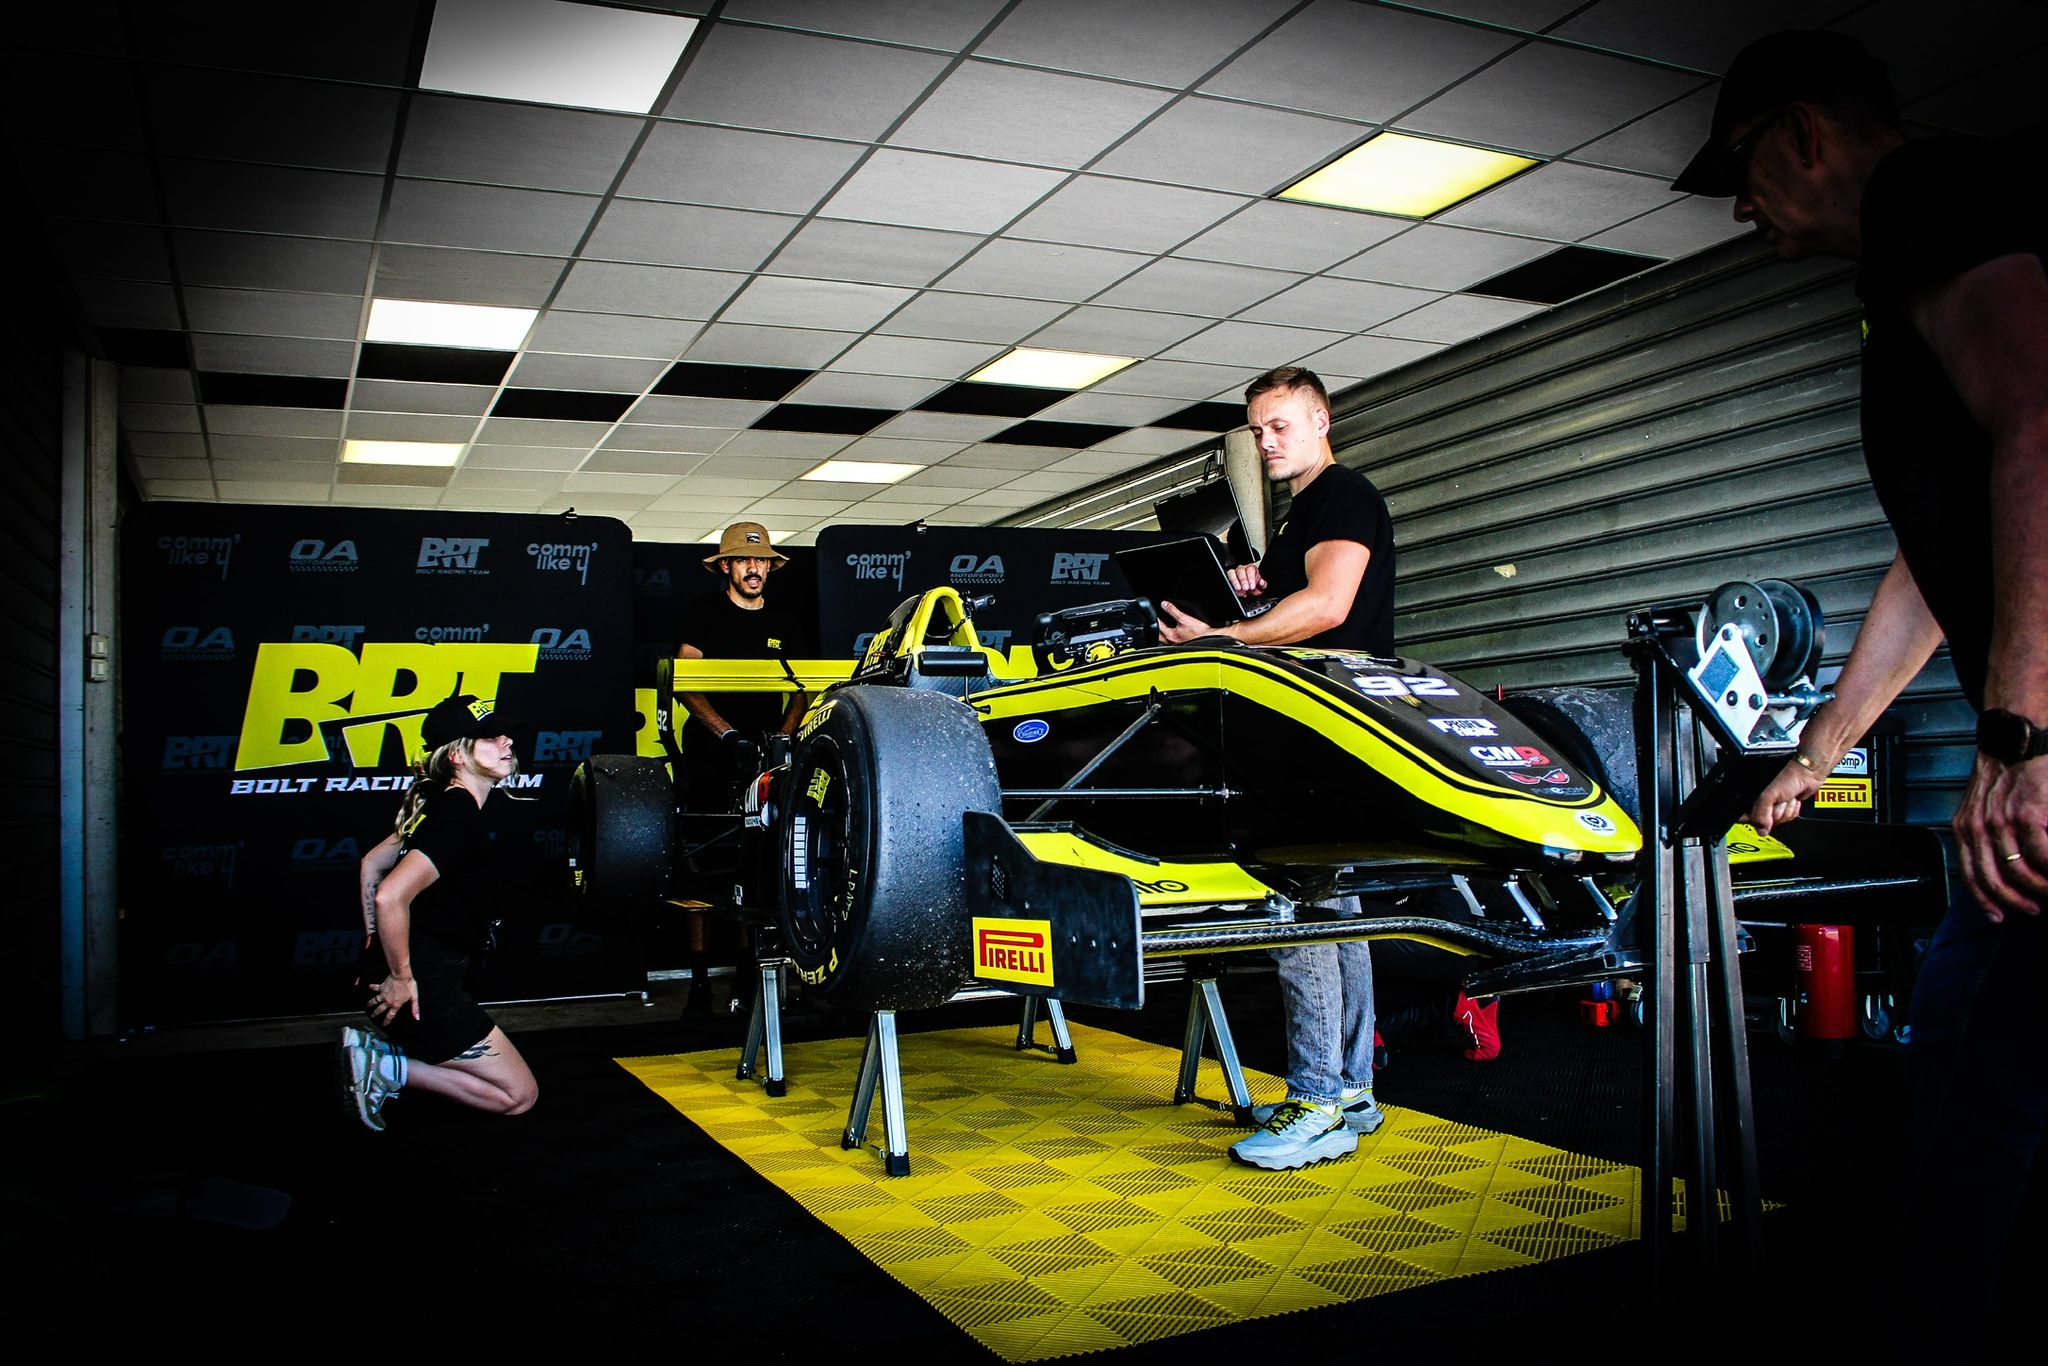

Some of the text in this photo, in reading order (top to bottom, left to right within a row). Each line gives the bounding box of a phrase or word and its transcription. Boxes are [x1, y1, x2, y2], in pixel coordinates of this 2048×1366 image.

[168, 550, 209, 566] like
[289, 538, 359, 560] OA
[416, 536, 491, 569] BRT
[526, 541, 599, 558] comm'
[846, 551, 912, 566] comm'
[536, 553, 571, 571] like
[855, 564, 891, 580] like
[949, 554, 1006, 573] OA
[1050, 552, 1110, 581] BRT
[160, 625, 235, 650] OA
[530, 627, 592, 650] OA
[1352, 675, 1460, 697] 92
[234, 642, 541, 772] BRT
[229, 777, 319, 795] BOLT
[324, 775, 415, 792] RACI
[290, 835, 360, 861] OA
[978, 928, 1046, 974] PIRELLI
